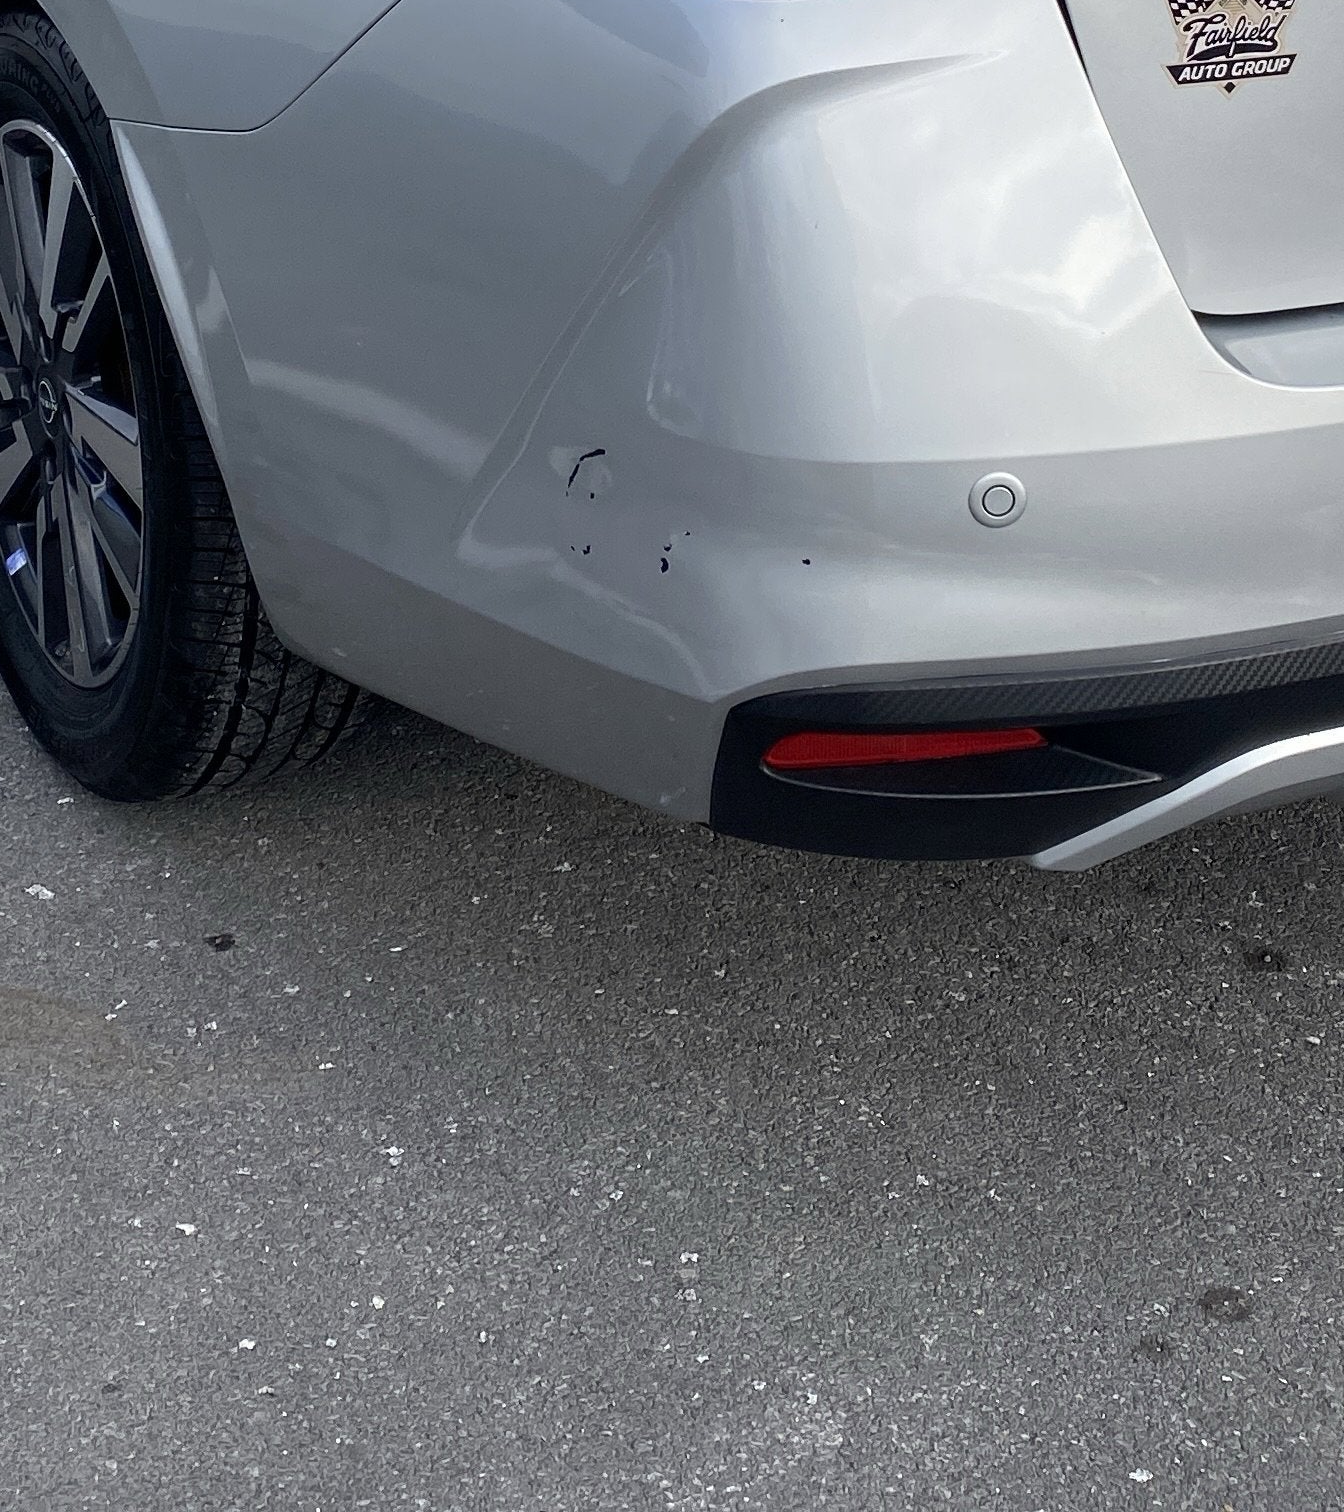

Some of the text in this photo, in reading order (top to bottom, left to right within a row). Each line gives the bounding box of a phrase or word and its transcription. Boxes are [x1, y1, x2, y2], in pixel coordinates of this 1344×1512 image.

[1182, 13, 1289, 61] Fairfield
[1178, 57, 1292, 82] AUTO GROUP
